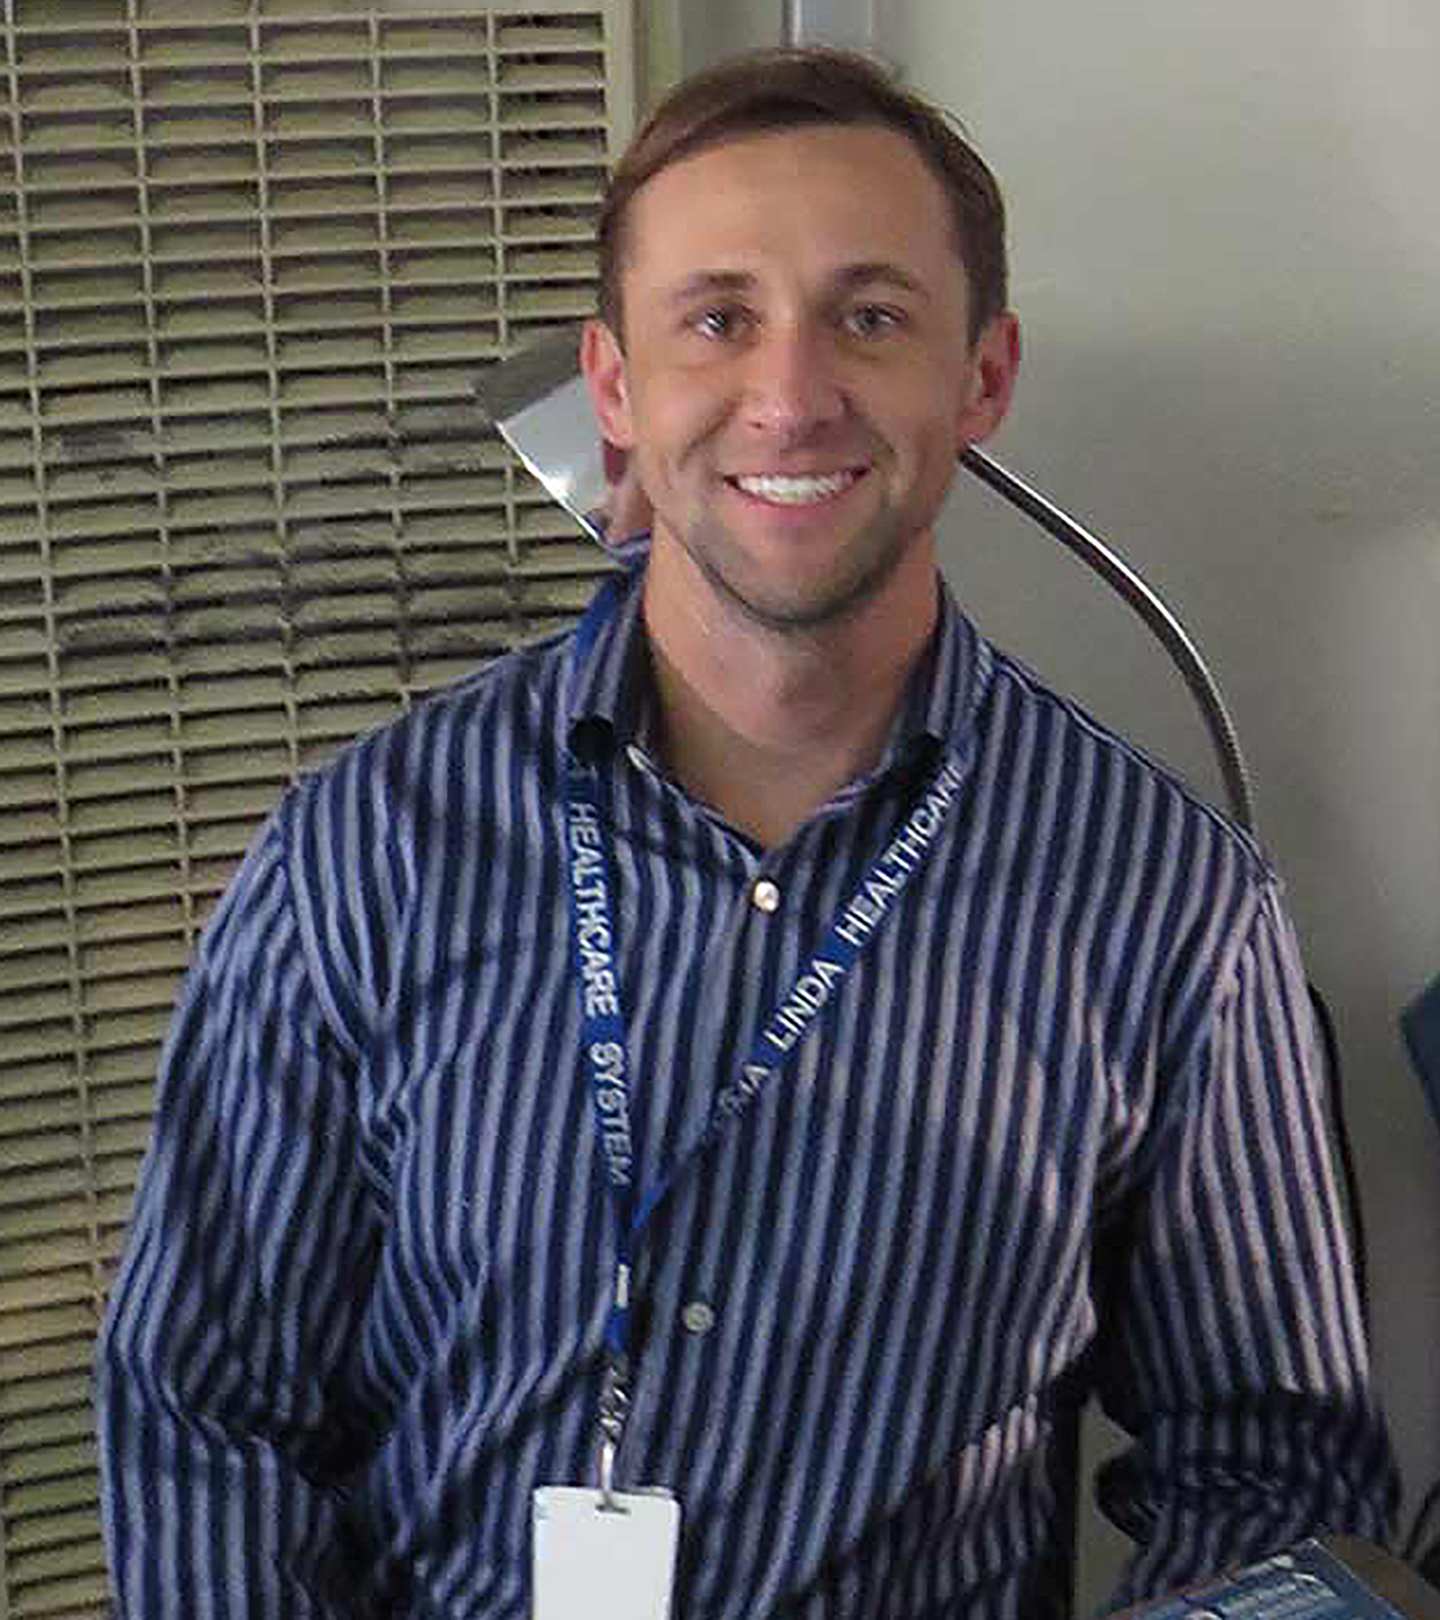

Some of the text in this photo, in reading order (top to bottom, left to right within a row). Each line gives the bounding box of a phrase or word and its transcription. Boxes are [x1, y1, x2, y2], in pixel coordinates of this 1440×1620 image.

[569, 801, 619, 1018] HEALTHCARE
[763, 957, 845, 1052] LINDA
[589, 1041, 633, 1186] SYSTEM
